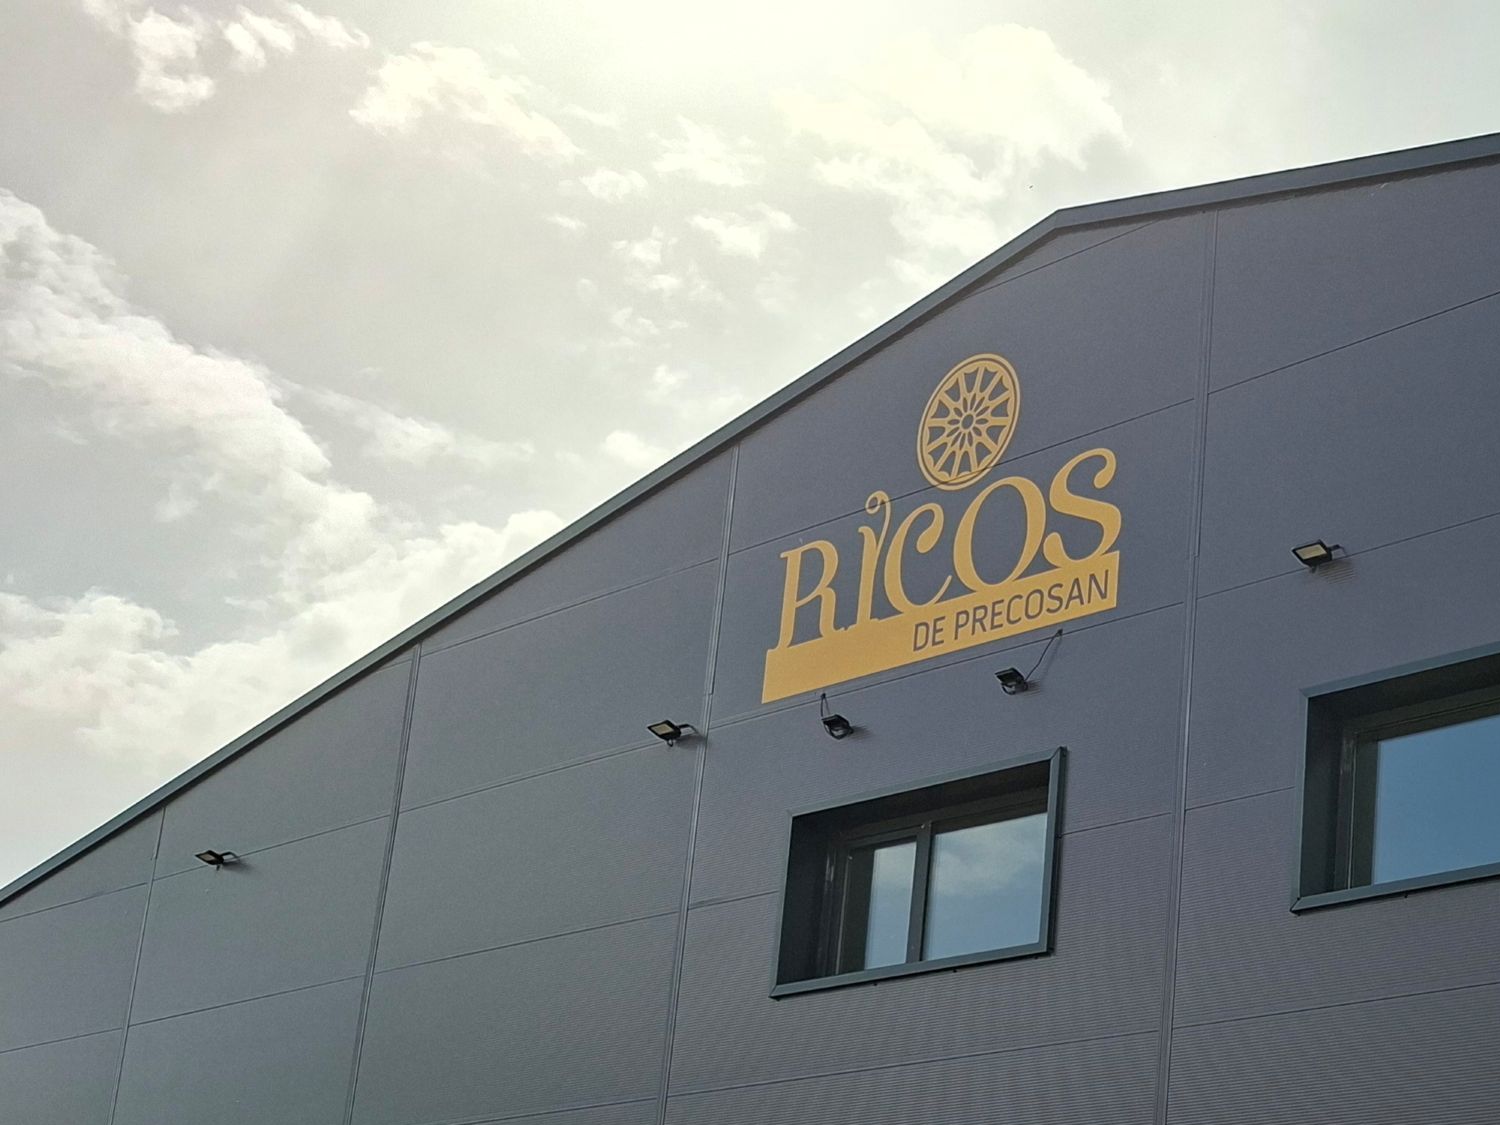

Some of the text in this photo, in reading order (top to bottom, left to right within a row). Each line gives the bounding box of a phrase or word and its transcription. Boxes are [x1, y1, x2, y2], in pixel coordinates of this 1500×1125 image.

[770, 448, 1122, 650] RICOS
[913, 569, 1110, 652] DE PRECOSAN
